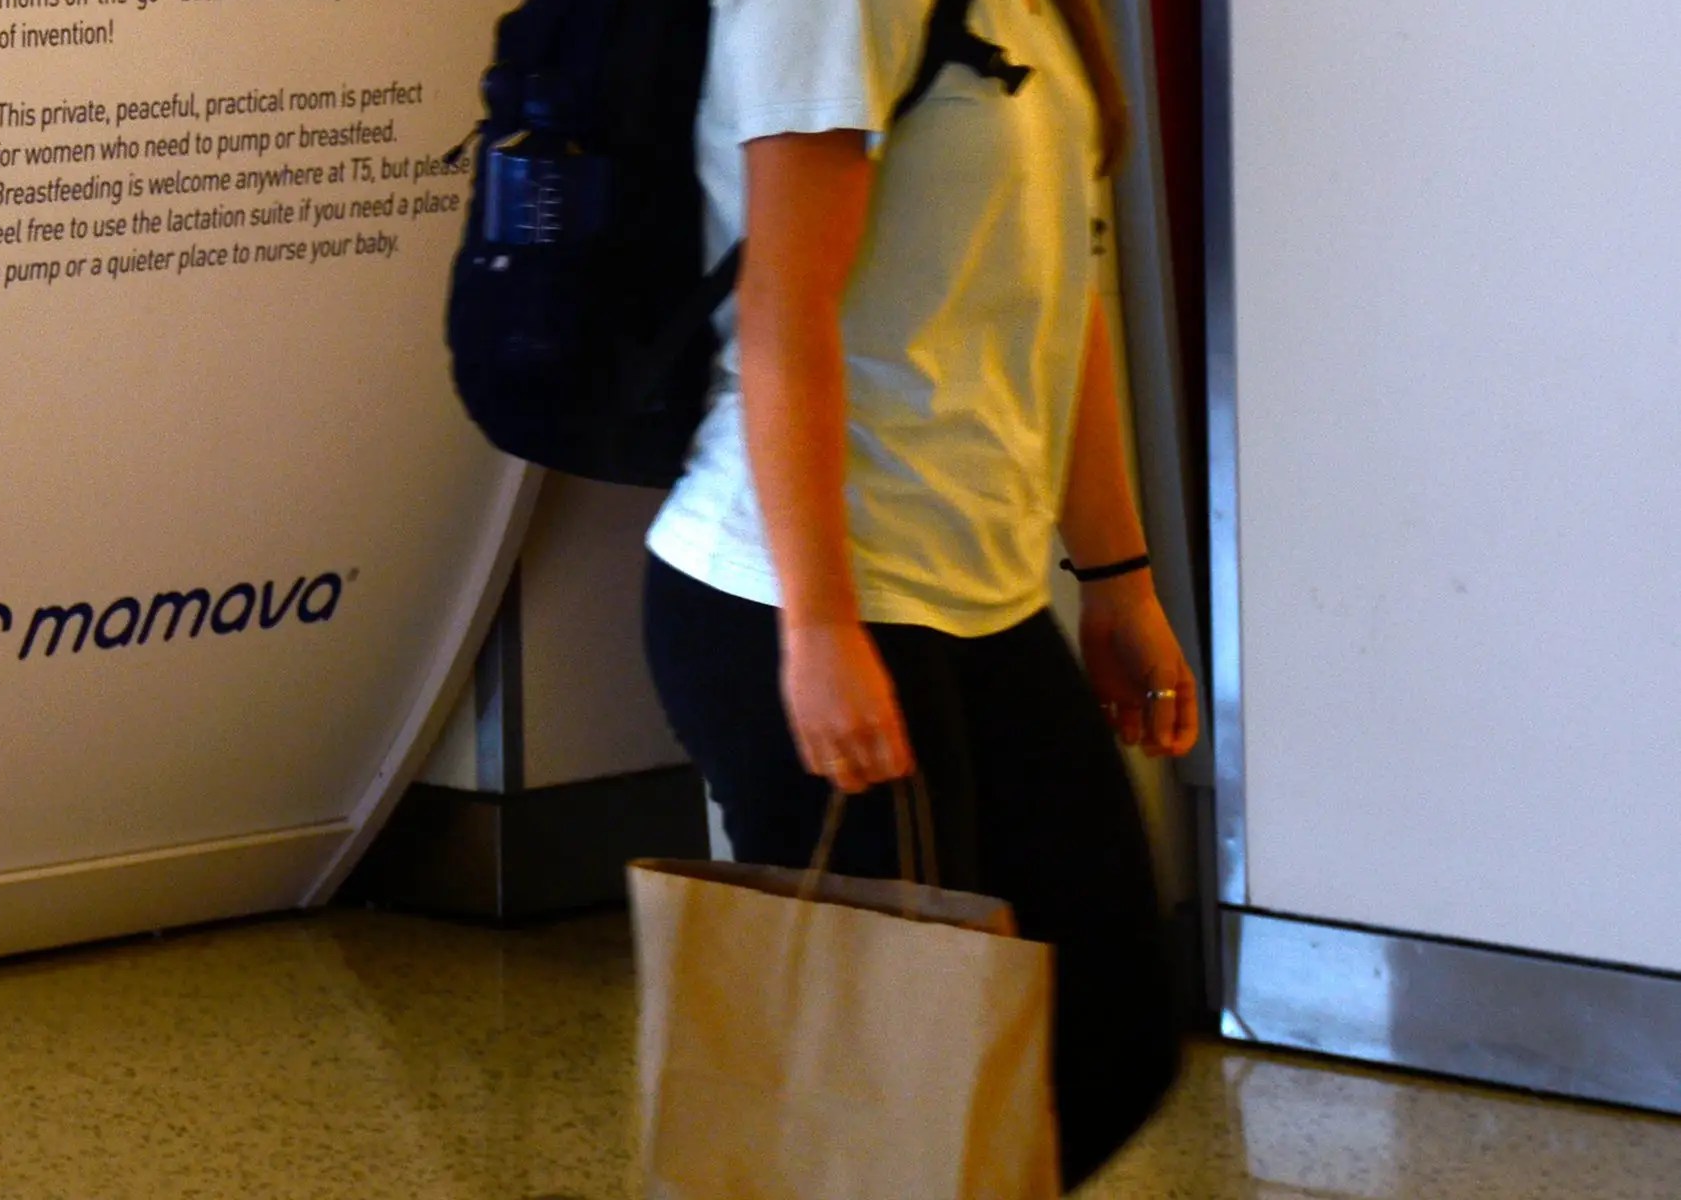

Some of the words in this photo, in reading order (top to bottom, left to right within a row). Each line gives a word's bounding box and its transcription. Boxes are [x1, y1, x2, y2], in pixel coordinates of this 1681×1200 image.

[21, 18, 114, 48] invention!
[41, 99, 111, 132] private,
[116, 92, 201, 127] peaceful,
[205, 87, 285, 122] practical
[289, 88, 337, 111] room
[341, 84, 356, 109] is
[360, 80, 423, 113] perfect
[25, 143, 95, 166] women
[100, 135, 140, 161] who
[145, 132, 190, 157] need
[196, 131, 213, 154] to
[217, 130, 270, 159] pump
[275, 131, 296, 150] or
[299, 119, 398, 148] breastfeed.
[128, 172, 144, 197] is
[148, 169, 231, 195] welcome
[235, 163, 323, 195] anywhere
[328, 160, 345, 184] at
[350, 156, 376, 184] T5,
[381, 155, 409, 180] but
[27, 218, 65, 243] free
[70, 217, 88, 239] to
[93, 216, 127, 238] use
[131, 209, 162, 234] the
[166, 203, 246, 232] lactation
[250, 202, 294, 226] suite
[298, 198, 310, 222] if
[312, 201, 346, 228] you
[350, 192, 394, 218] need
[397, 197, 408, 216] a
[412, 190, 460, 221] place
[3, 259, 61, 290] pump
[65, 258, 88, 278] or
[90, 256, 102, 276] a
[107, 248, 174, 280] quieter
[177, 243, 229, 276] place
[232, 243, 250, 265] to
[254, 241, 308, 263] nurse
[310, 237, 352, 265] your
[355, 230, 399, 258] baby.
[18, 570, 343, 661] mamava
